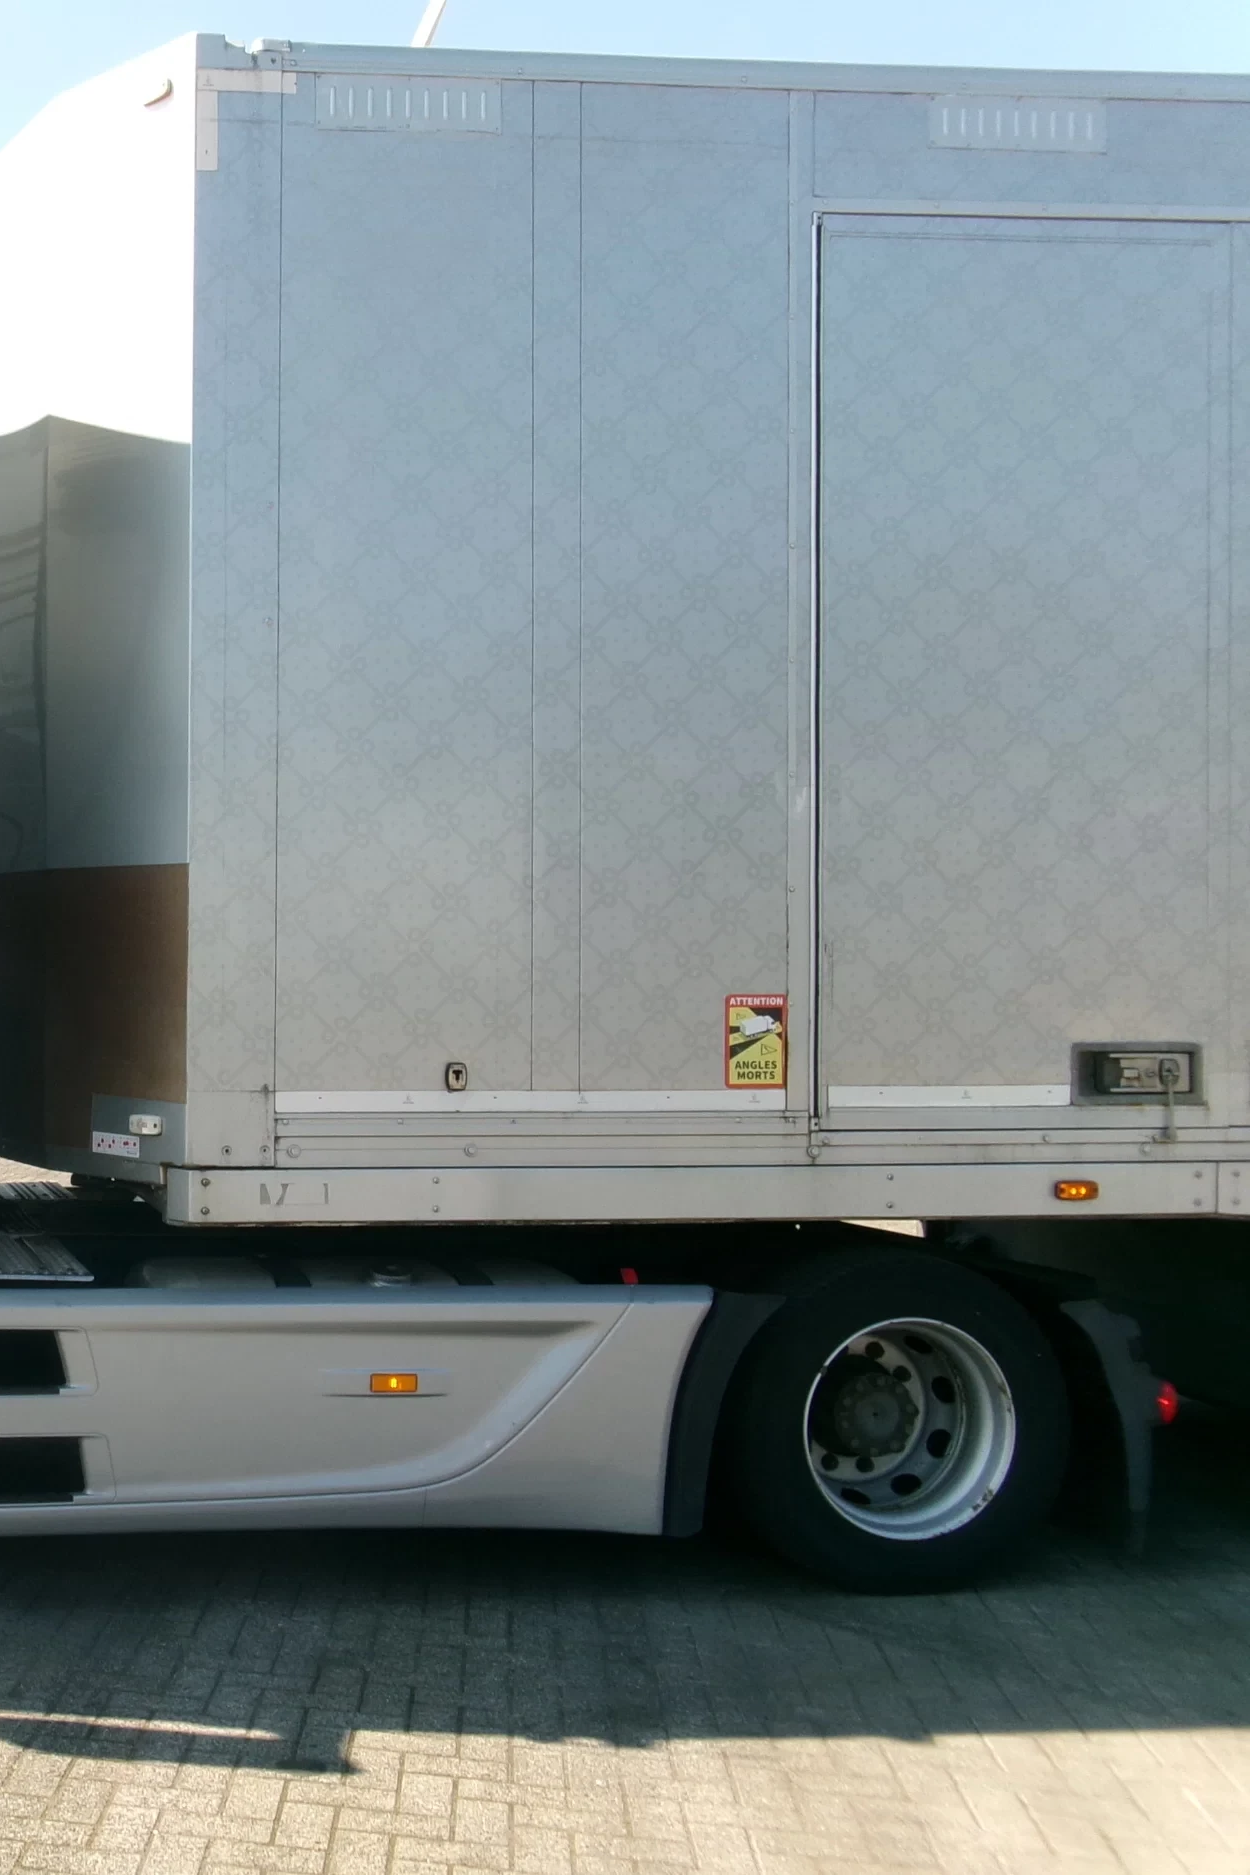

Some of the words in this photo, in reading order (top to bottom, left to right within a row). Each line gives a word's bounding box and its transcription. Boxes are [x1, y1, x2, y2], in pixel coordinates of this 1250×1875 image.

[730, 997, 783, 1005] ATTENTION
[734, 1060, 778, 1070] ANGLES
[737, 1070, 776, 1080] MORTS
